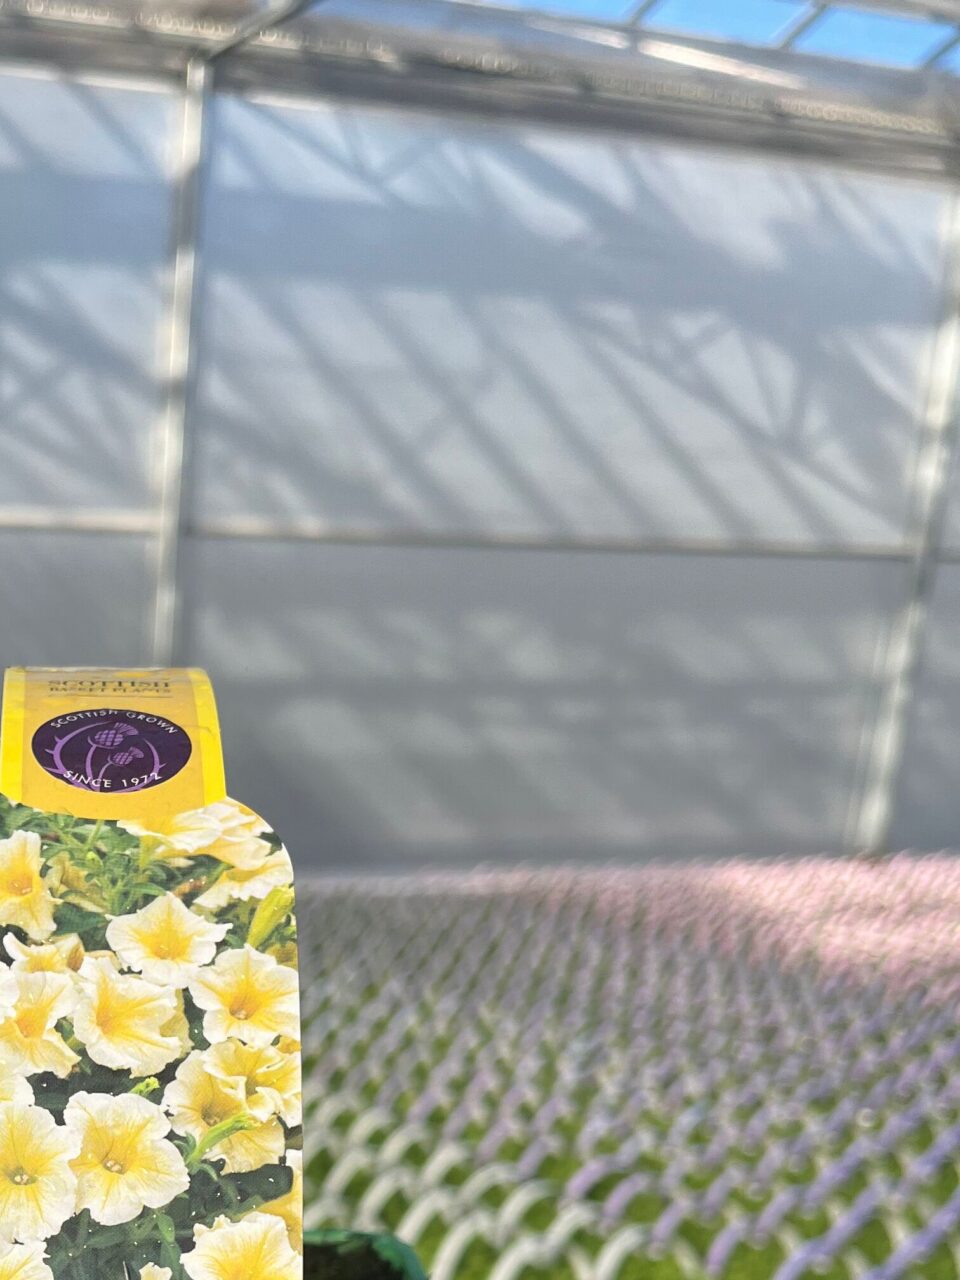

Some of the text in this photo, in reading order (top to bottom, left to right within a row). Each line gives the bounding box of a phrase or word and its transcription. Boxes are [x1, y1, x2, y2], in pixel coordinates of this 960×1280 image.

[48, 679, 170, 688] SCOTTISH
[50, 709, 178, 734] SCOTTISH GROWN
[63, 770, 162, 788] SINCE 1972
